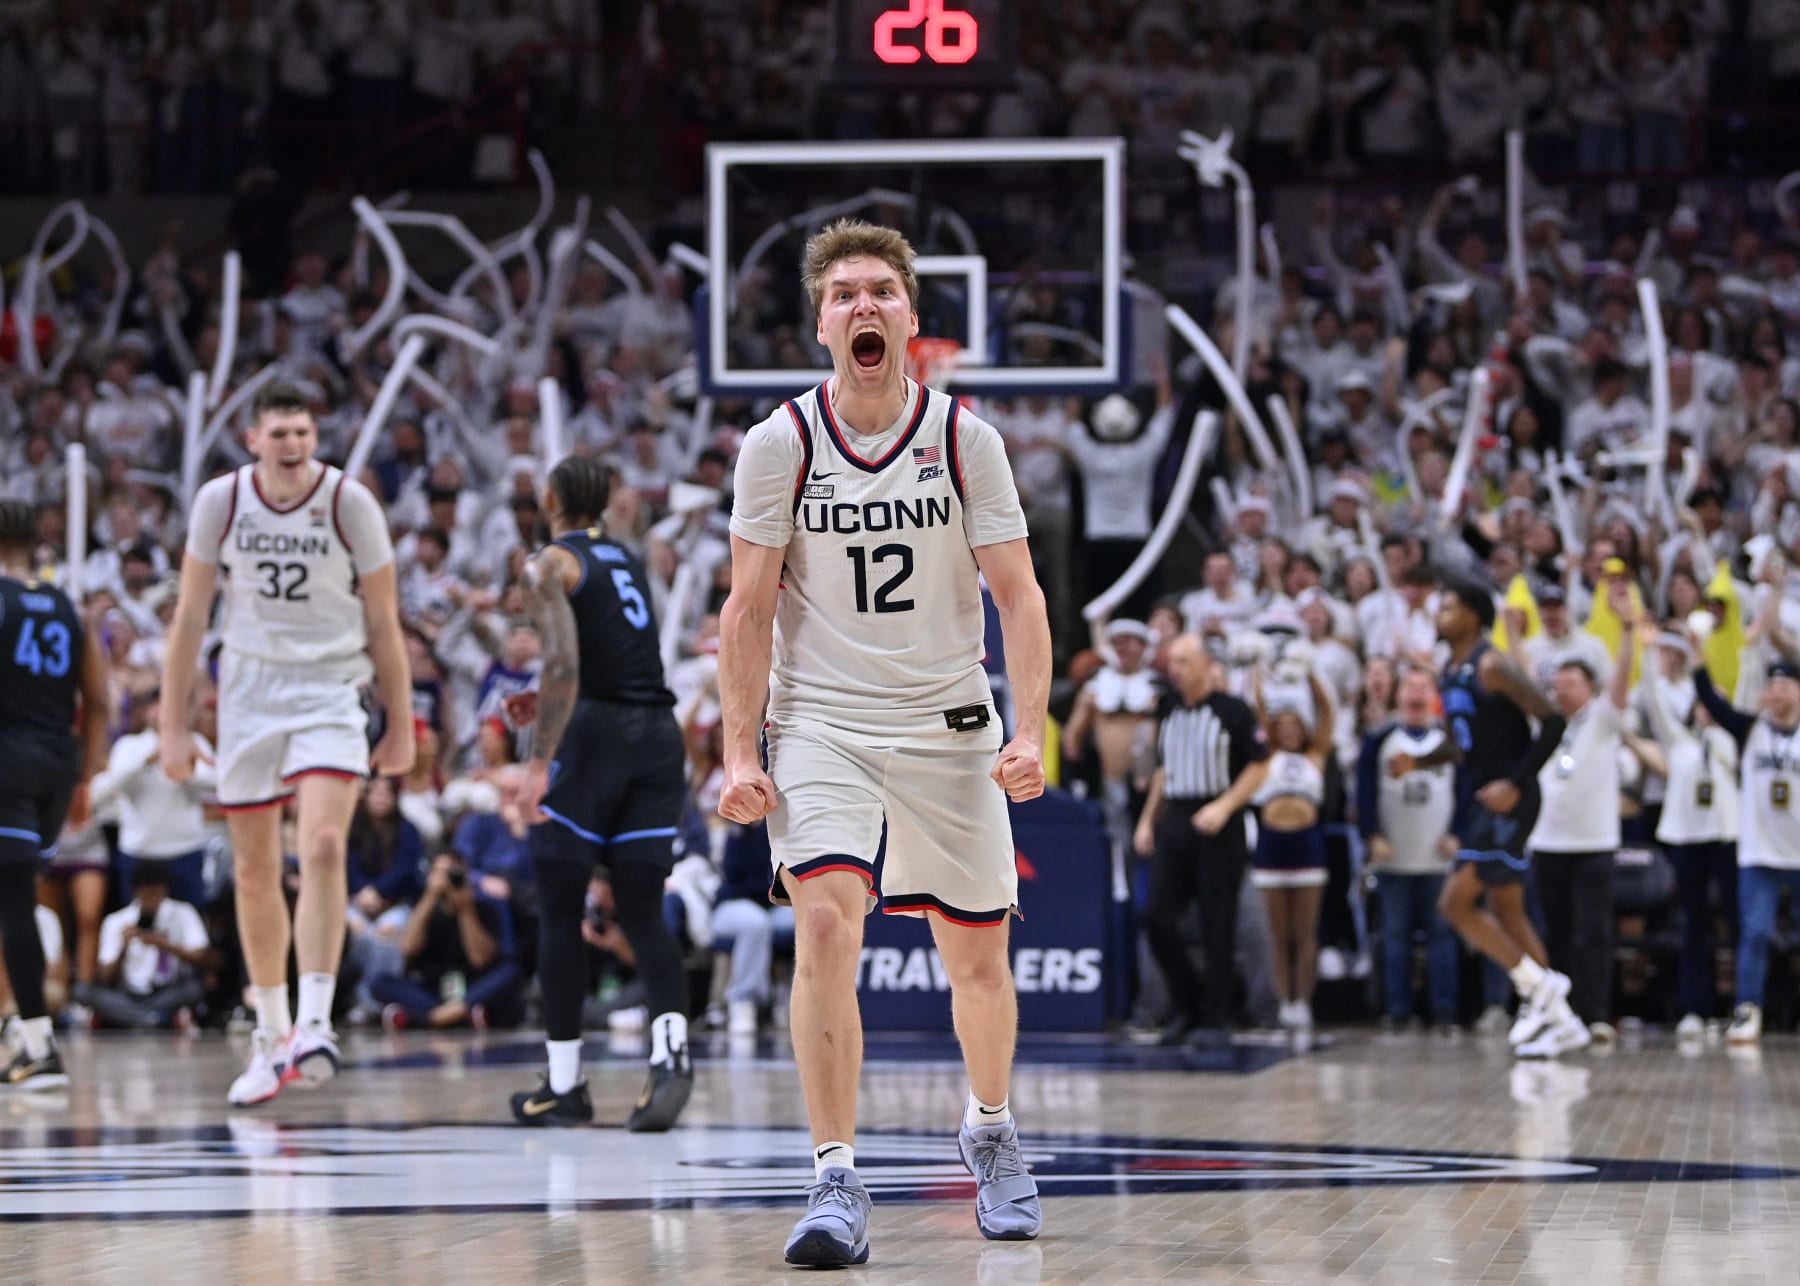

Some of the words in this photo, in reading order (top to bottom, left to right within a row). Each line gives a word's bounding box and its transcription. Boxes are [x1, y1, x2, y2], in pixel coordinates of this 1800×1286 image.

[874, 0, 978, 64] 26
[918, 469, 944, 480] EAST
[920, 465, 938, 474] BIG
[804, 496, 950, 534] UCONN
[236, 532, 330, 555] UCONN
[257, 560, 311, 602] 32
[610, 567, 650, 630] 5
[846, 543, 915, 613] 12
[14, 616, 71, 678] 43
[854, 947, 1103, 993] TRAVERS
